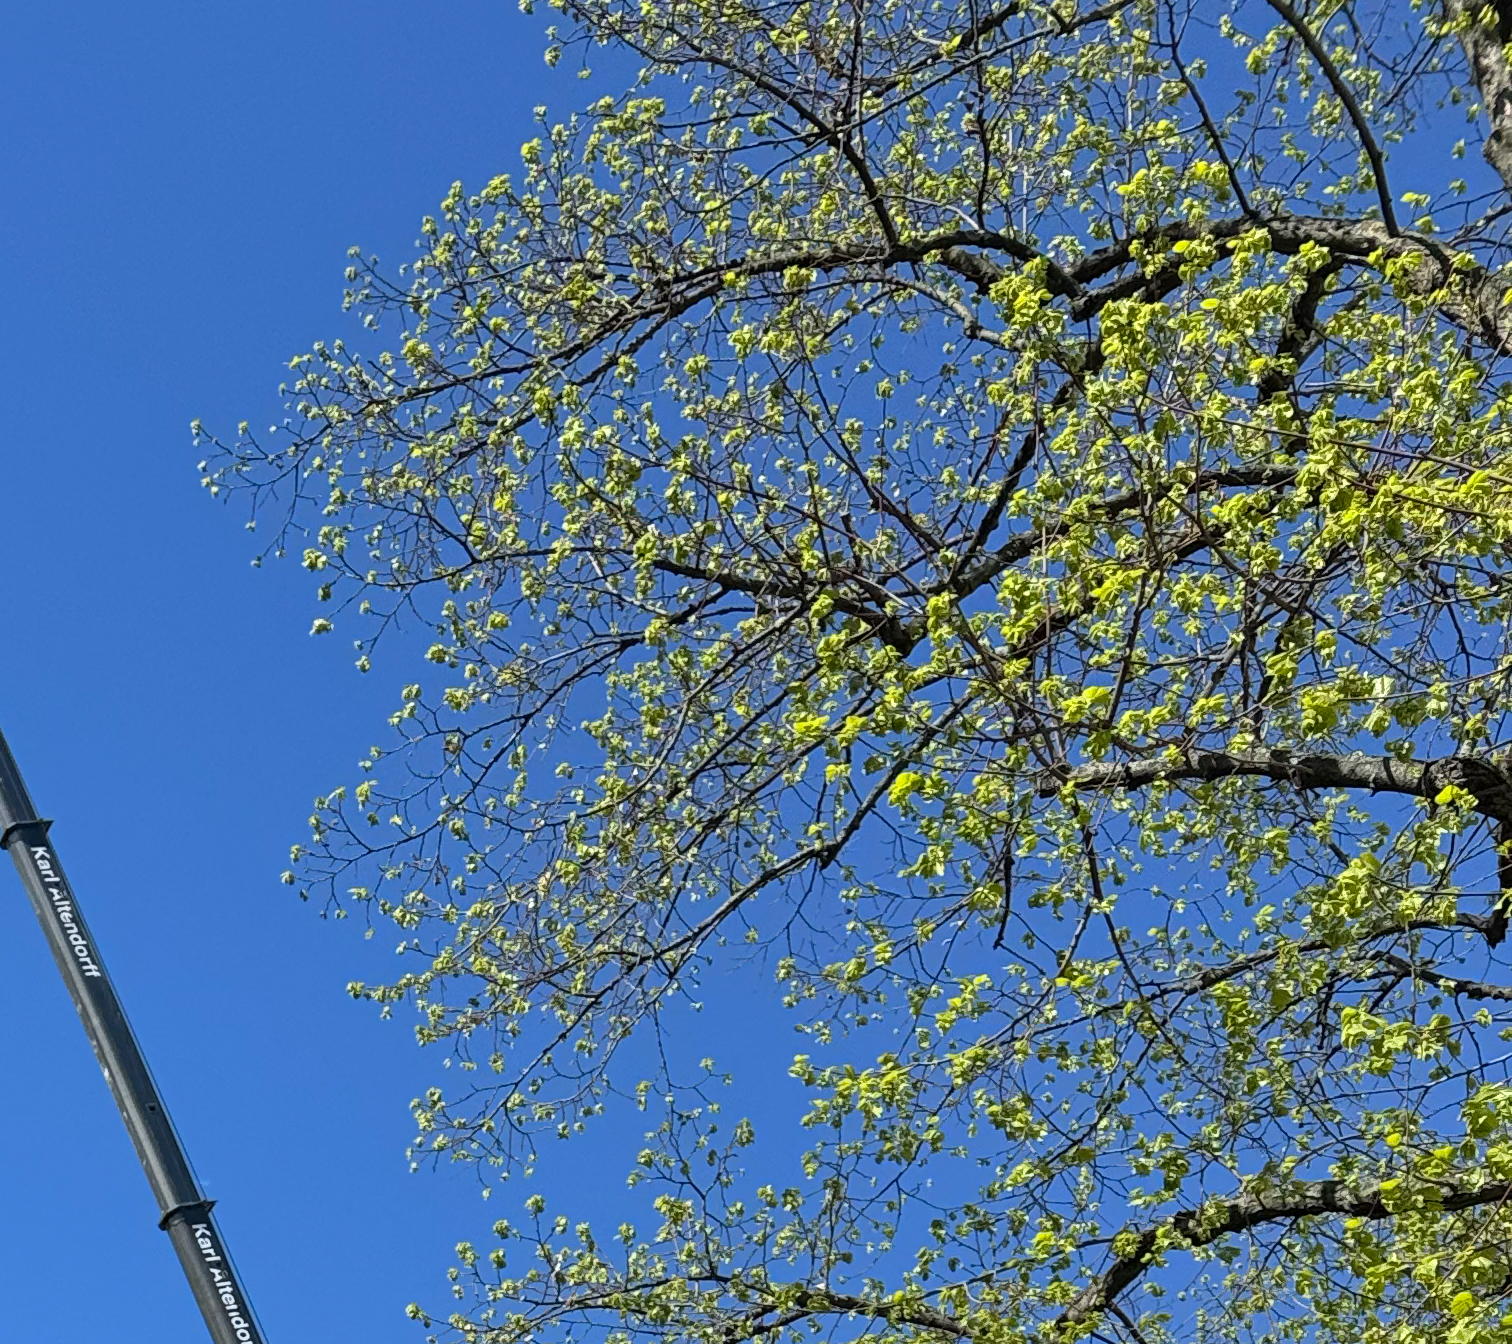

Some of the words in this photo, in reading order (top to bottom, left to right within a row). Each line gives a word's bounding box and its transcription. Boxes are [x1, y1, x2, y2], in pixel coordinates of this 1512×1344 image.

[30, 846, 61, 883] Karl
[48, 887, 102, 978] Altendorff
[192, 1223, 222, 1262] Karl
